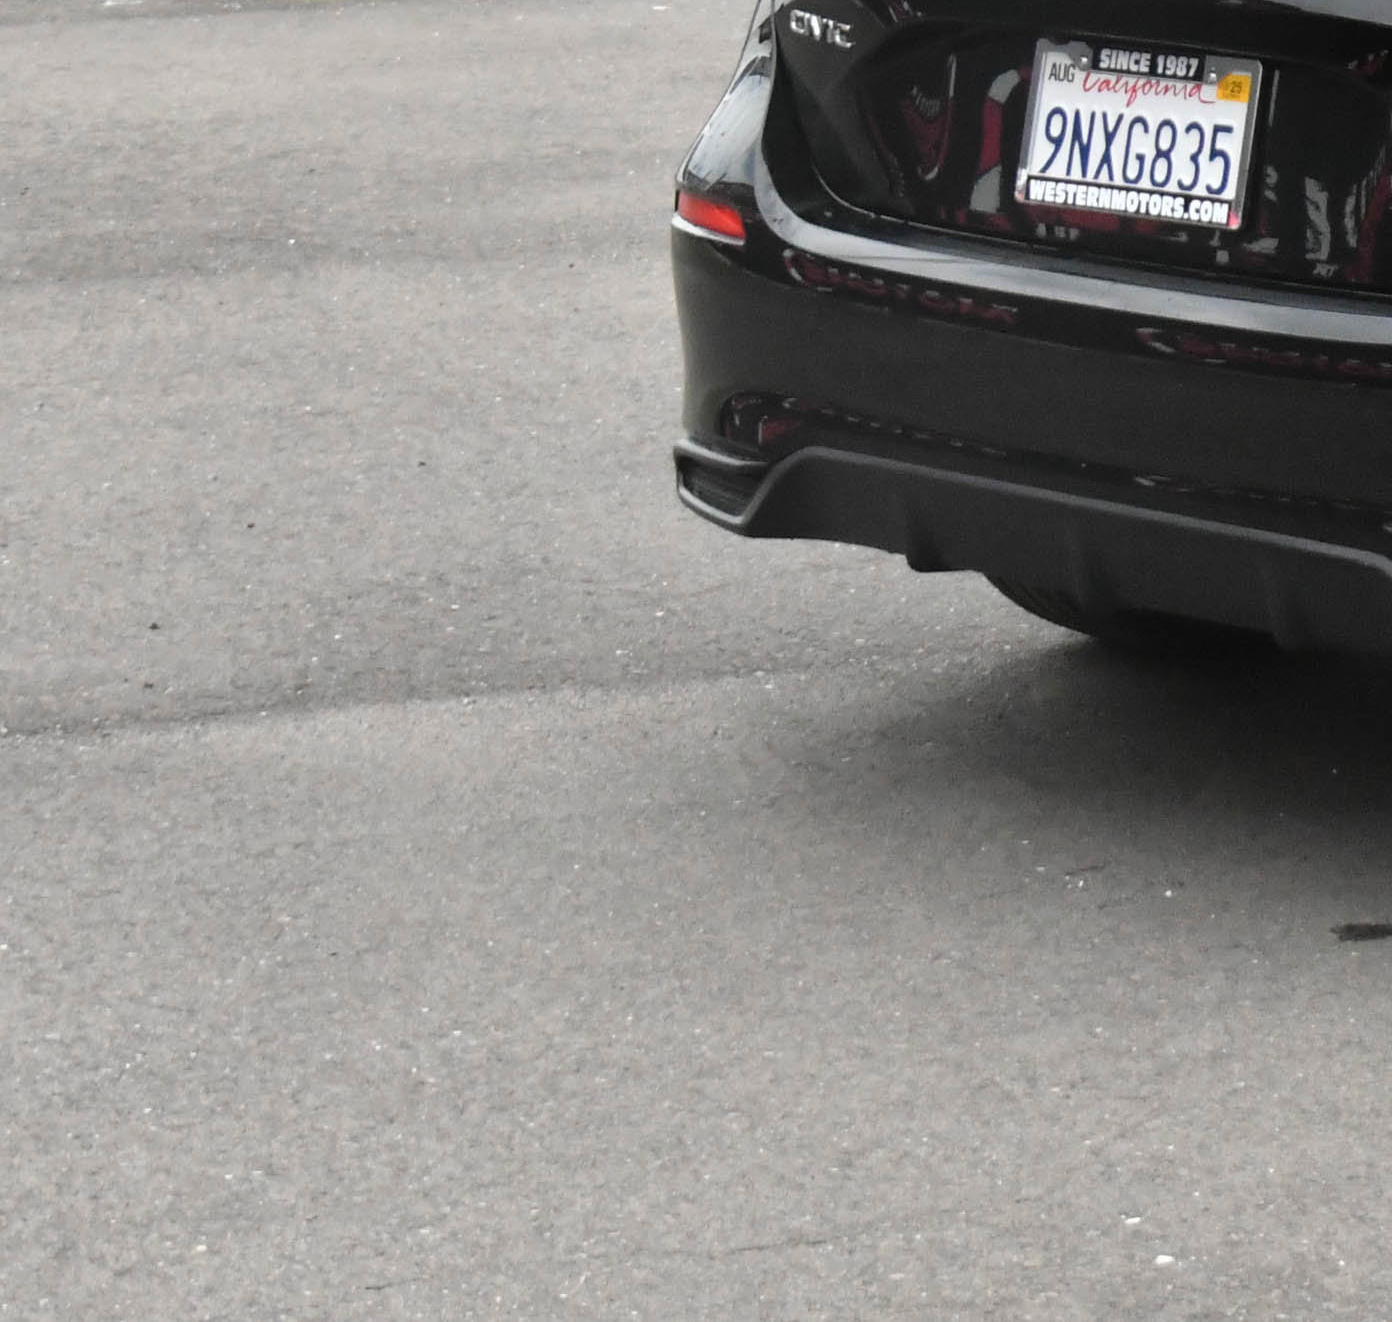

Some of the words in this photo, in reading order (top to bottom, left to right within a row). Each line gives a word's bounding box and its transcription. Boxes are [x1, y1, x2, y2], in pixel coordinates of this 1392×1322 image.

[1047, 61, 1077, 83] AUG
[1098, 47, 1152, 74] SINCE
[1155, 54, 1200, 78] 1987
[1082, 69, 1217, 108] California
[1040, 106, 1234, 195] 9NXG835
[1028, 179, 1230, 224] WESTERNMOTORS.COM
